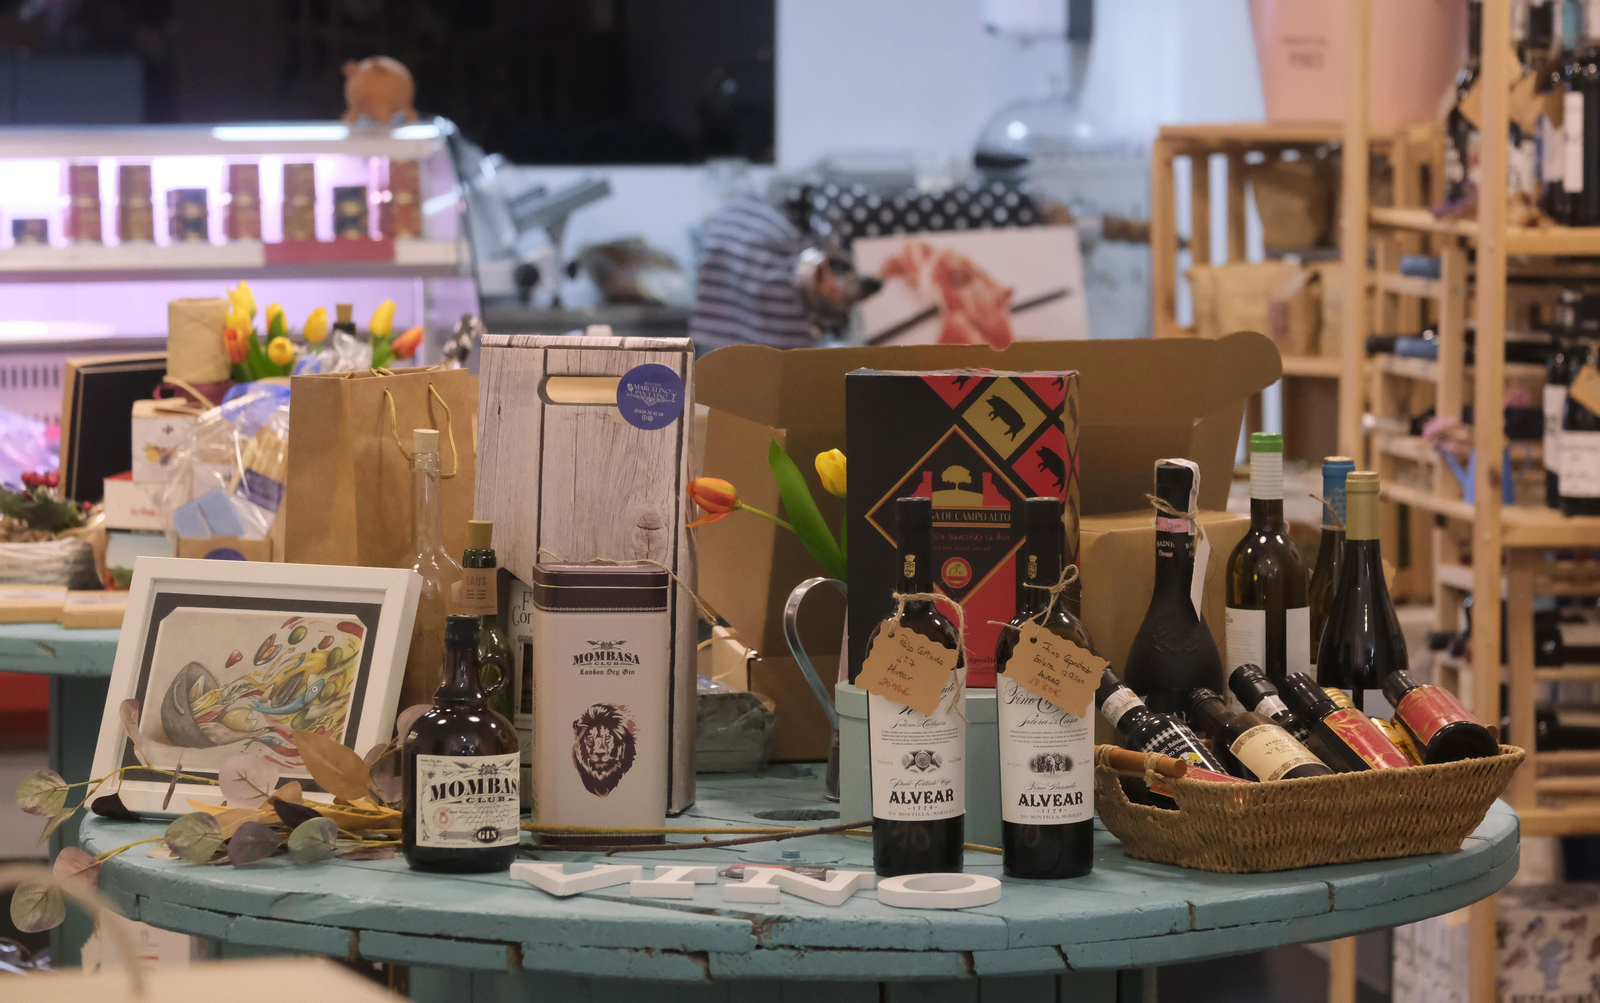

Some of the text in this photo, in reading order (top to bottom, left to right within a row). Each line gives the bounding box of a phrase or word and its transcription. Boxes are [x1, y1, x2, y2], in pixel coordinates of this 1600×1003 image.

[941, 511, 953, 520] DE
[954, 512, 987, 521] CAMPO
[988, 512, 1011, 521] ALTO
[466, 577, 487, 586] LAUS
[1042, 641, 1060, 658] Fino
[573, 651, 640, 665] MOMBASA
[606, 668, 620, 676] Dry
[429, 778, 520, 802] MOMBAS
[889, 788, 954, 804] ALVEAR
[1018, 791, 1084, 807] ALVEAR
[478, 830, 498, 840] GIN
